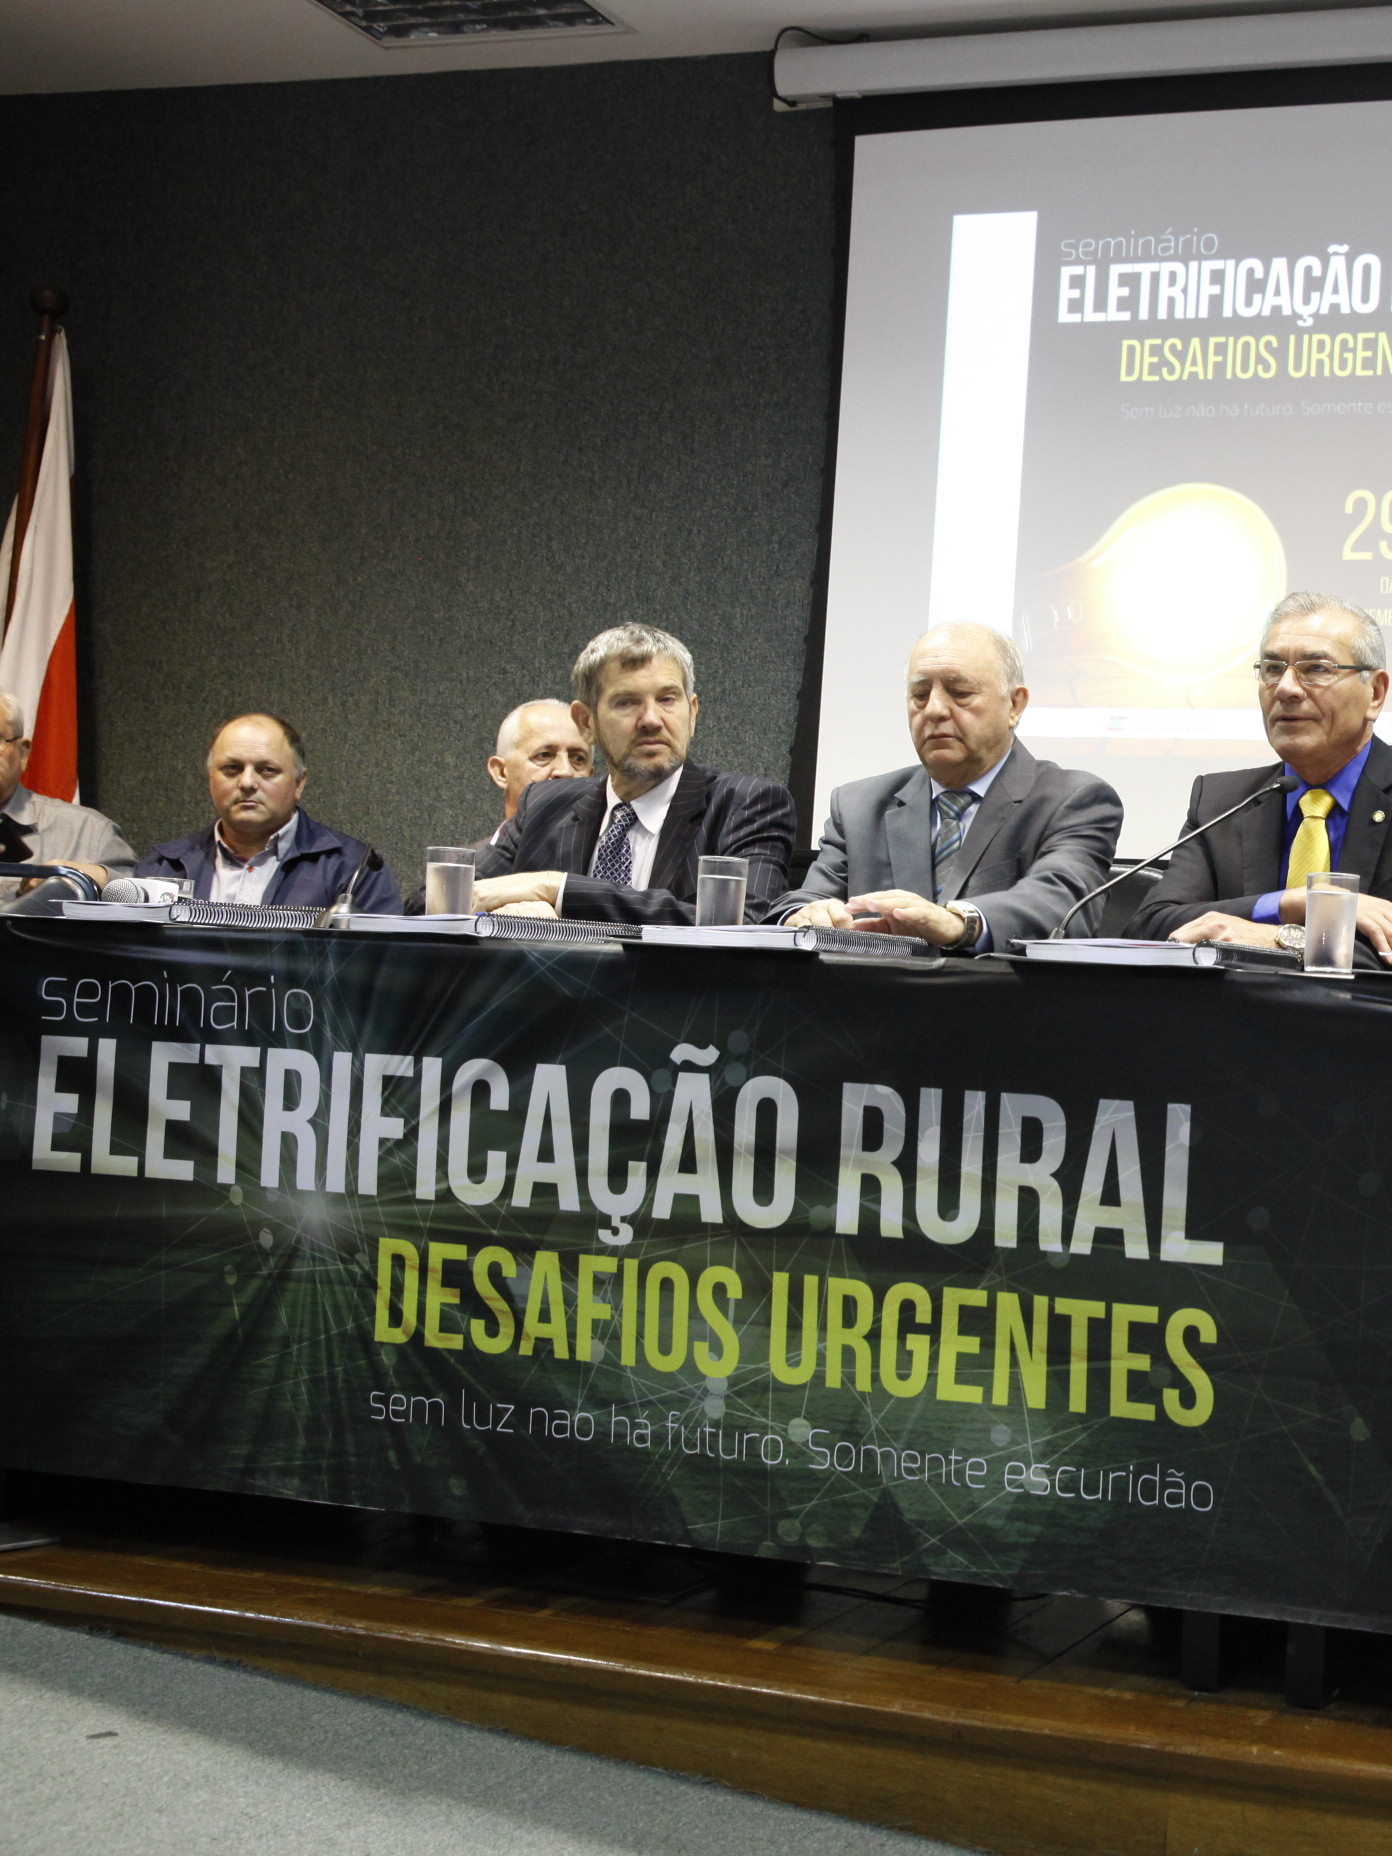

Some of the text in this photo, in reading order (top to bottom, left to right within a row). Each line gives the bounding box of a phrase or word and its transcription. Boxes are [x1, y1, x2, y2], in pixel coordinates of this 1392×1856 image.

[1060, 228, 1218, 261] seminário
[1058, 244, 1381, 327] ELETRIFICAÇÃO
[1120, 334, 1277, 382] DESAFIOS
[1120, 403, 1154, 420] Sem
[1159, 402, 1183, 419] luz
[1186, 402, 1216, 418] não
[1219, 401, 1240, 417] há
[1244, 400, 1297, 417] futuro.
[1300, 399, 1372, 416] Somente
[41, 970, 314, 1034] seminário
[31, 1034, 1224, 1266] ELETRIFICAÇÃO RURAL
[374, 1237, 1218, 1428] DESAFIOS URGENTES
[370, 1391, 445, 1426] sem
[461, 1389, 515, 1433] luz
[611, 1403, 651, 1448] há
[665, 1411, 790, 1466] futuro.
[808, 1429, 988, 1488] Somente
[1004, 1463, 1214, 1511] escuridão
